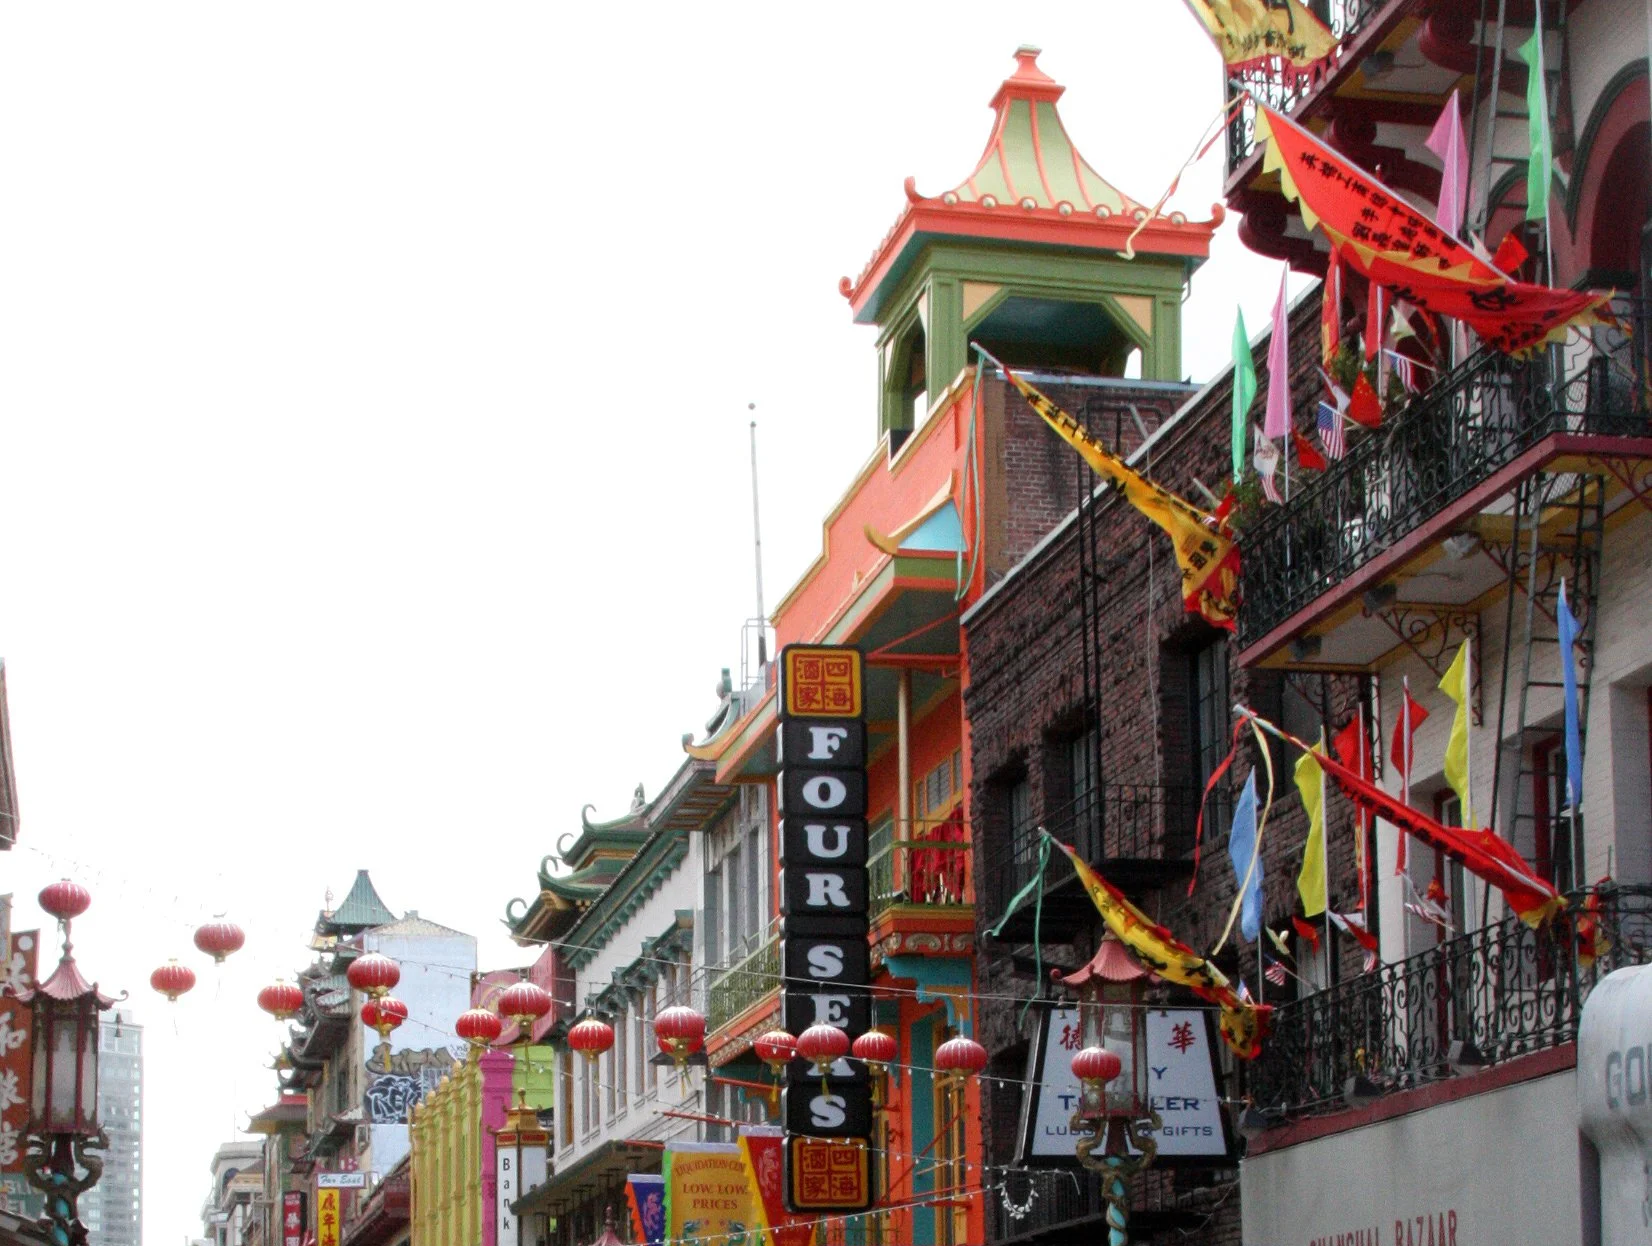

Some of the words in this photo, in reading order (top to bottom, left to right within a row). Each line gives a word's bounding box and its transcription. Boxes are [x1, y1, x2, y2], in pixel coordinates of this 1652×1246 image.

[802, 726, 851, 907] FOUR
[1163, 1126, 1213, 1137] GIFTS
[502, 1157, 511, 1231] Bank
[692, 1199, 738, 1211] PRICES
